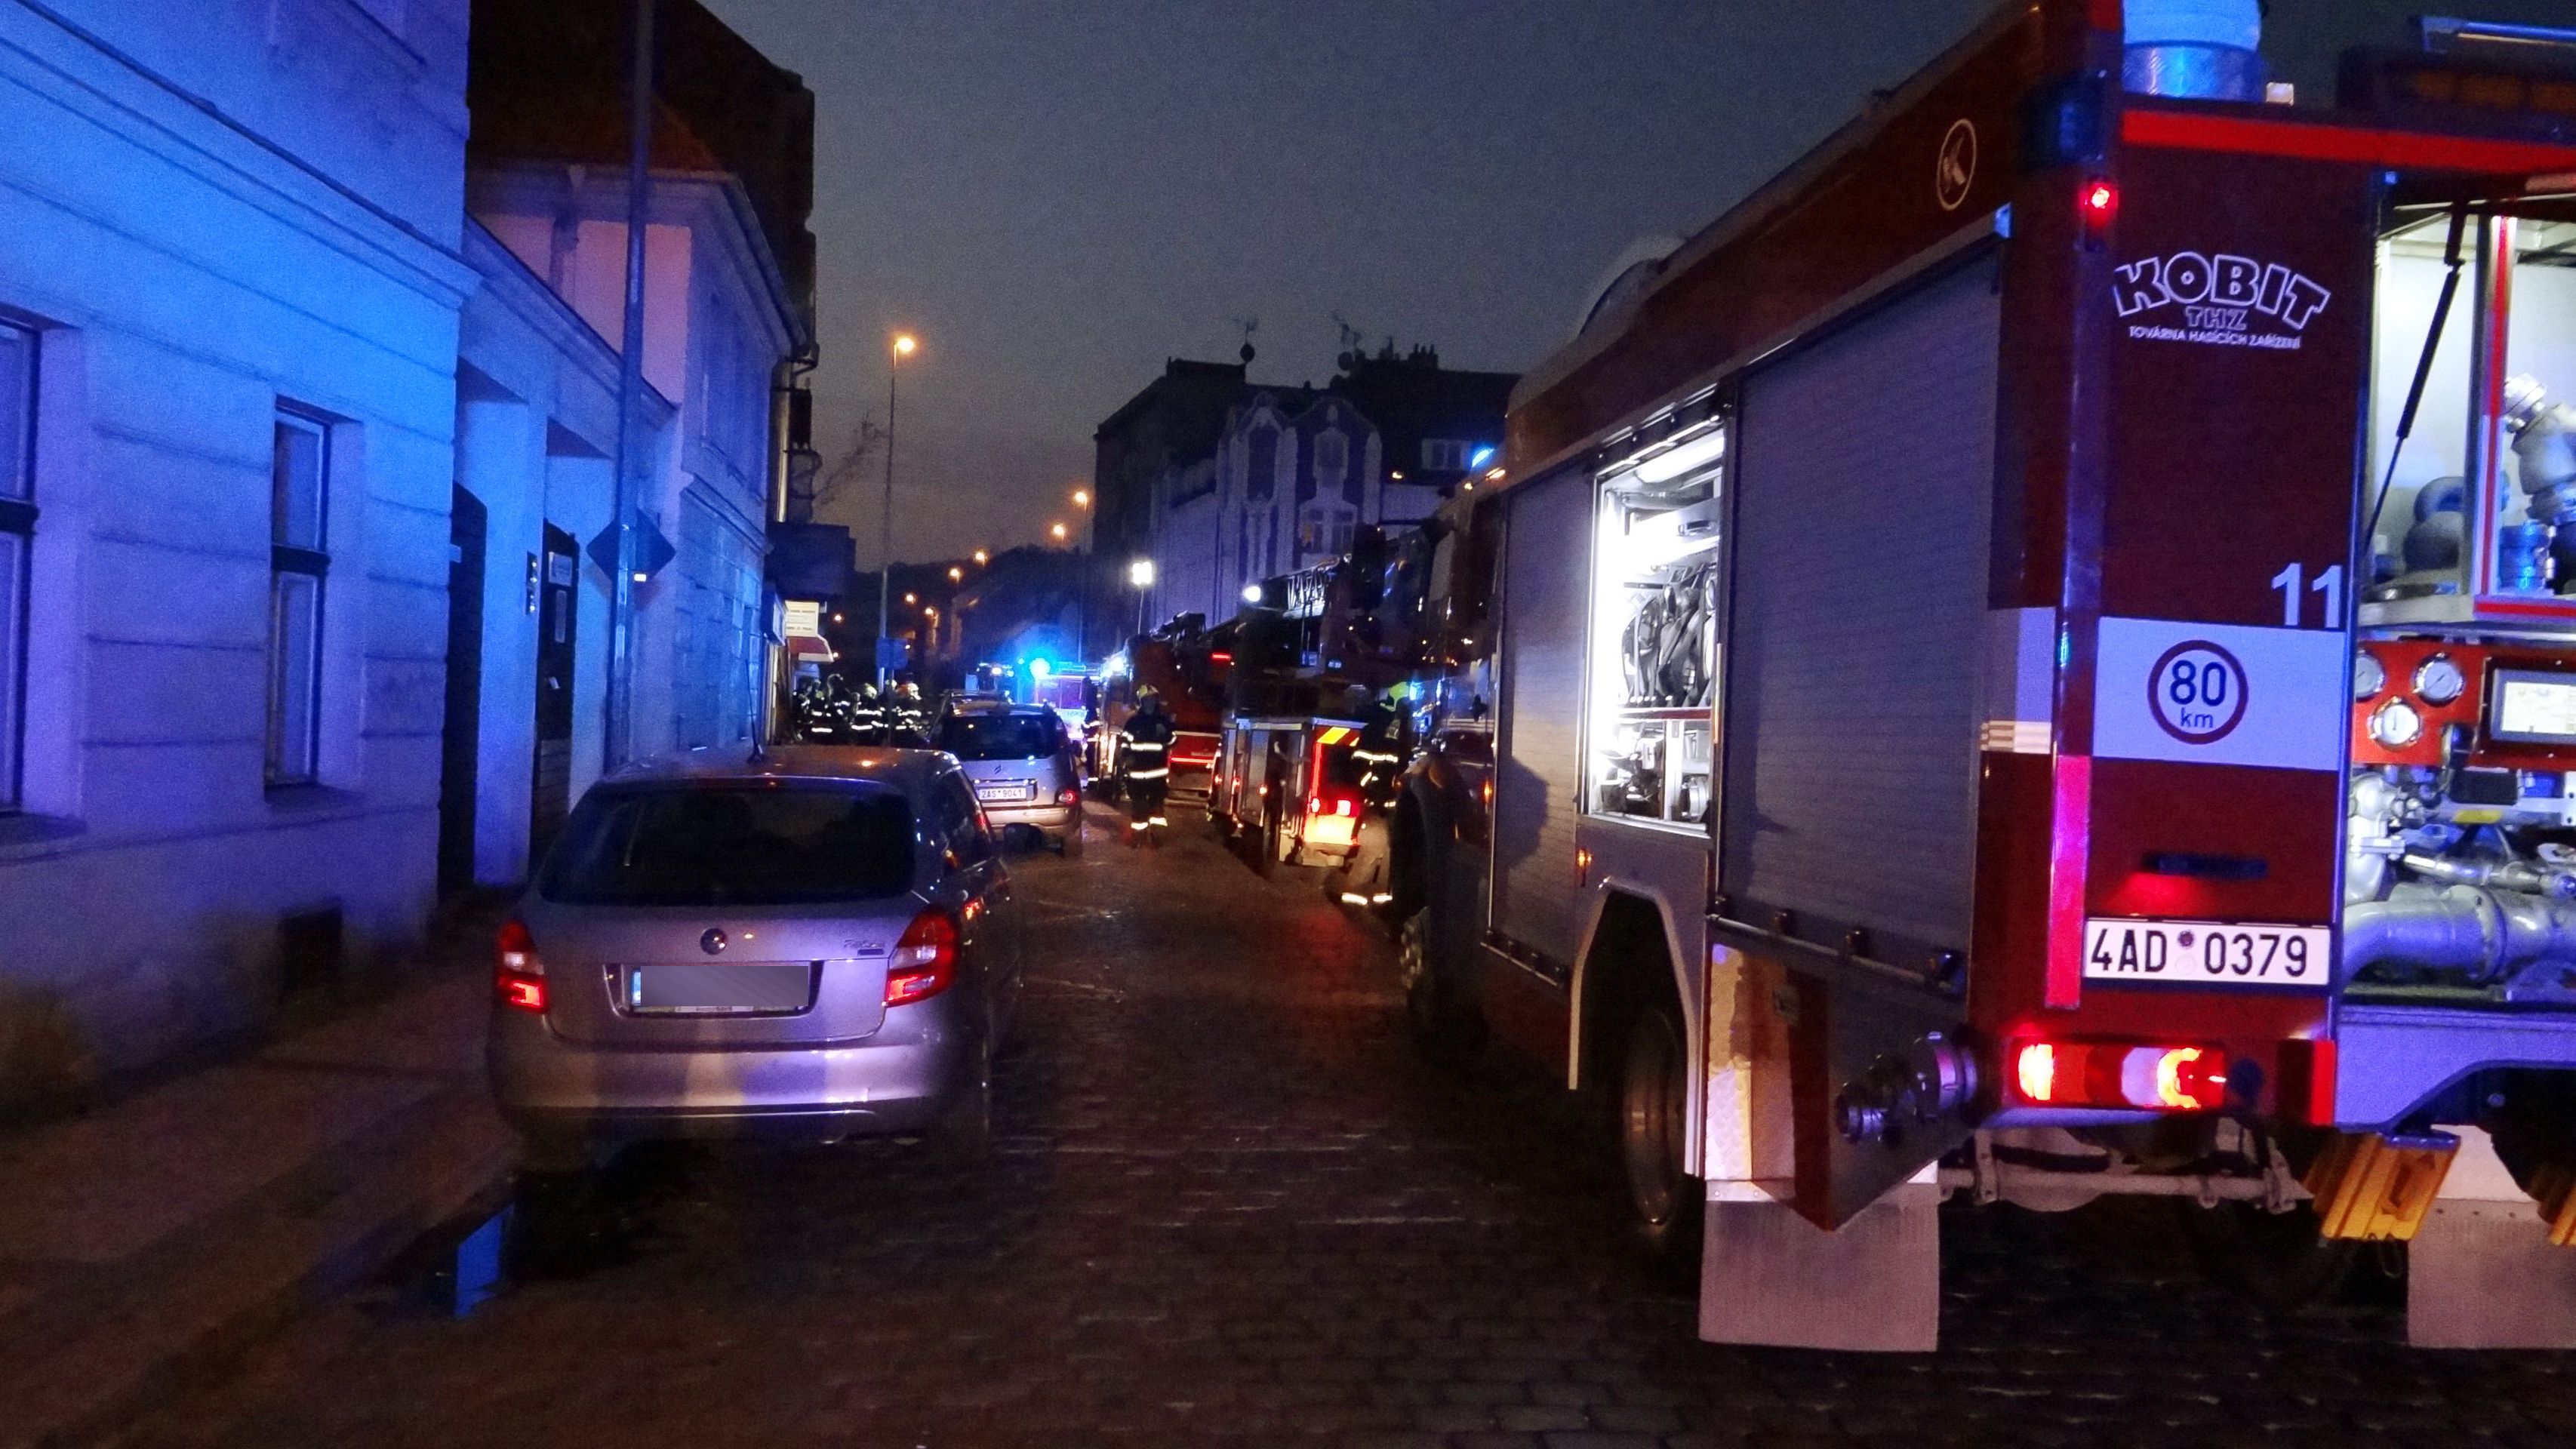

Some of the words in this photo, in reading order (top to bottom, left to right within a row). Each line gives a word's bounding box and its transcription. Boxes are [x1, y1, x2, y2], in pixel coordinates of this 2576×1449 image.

[2113, 251, 2331, 330] KOBIT
[2185, 305, 2248, 331] THZ
[2270, 562, 2343, 629] 11
[2169, 660, 2227, 707] 80
[2181, 707, 2214, 728] km
[2091, 928, 2167, 973] 4AD
[2204, 932, 2307, 977] 0379
